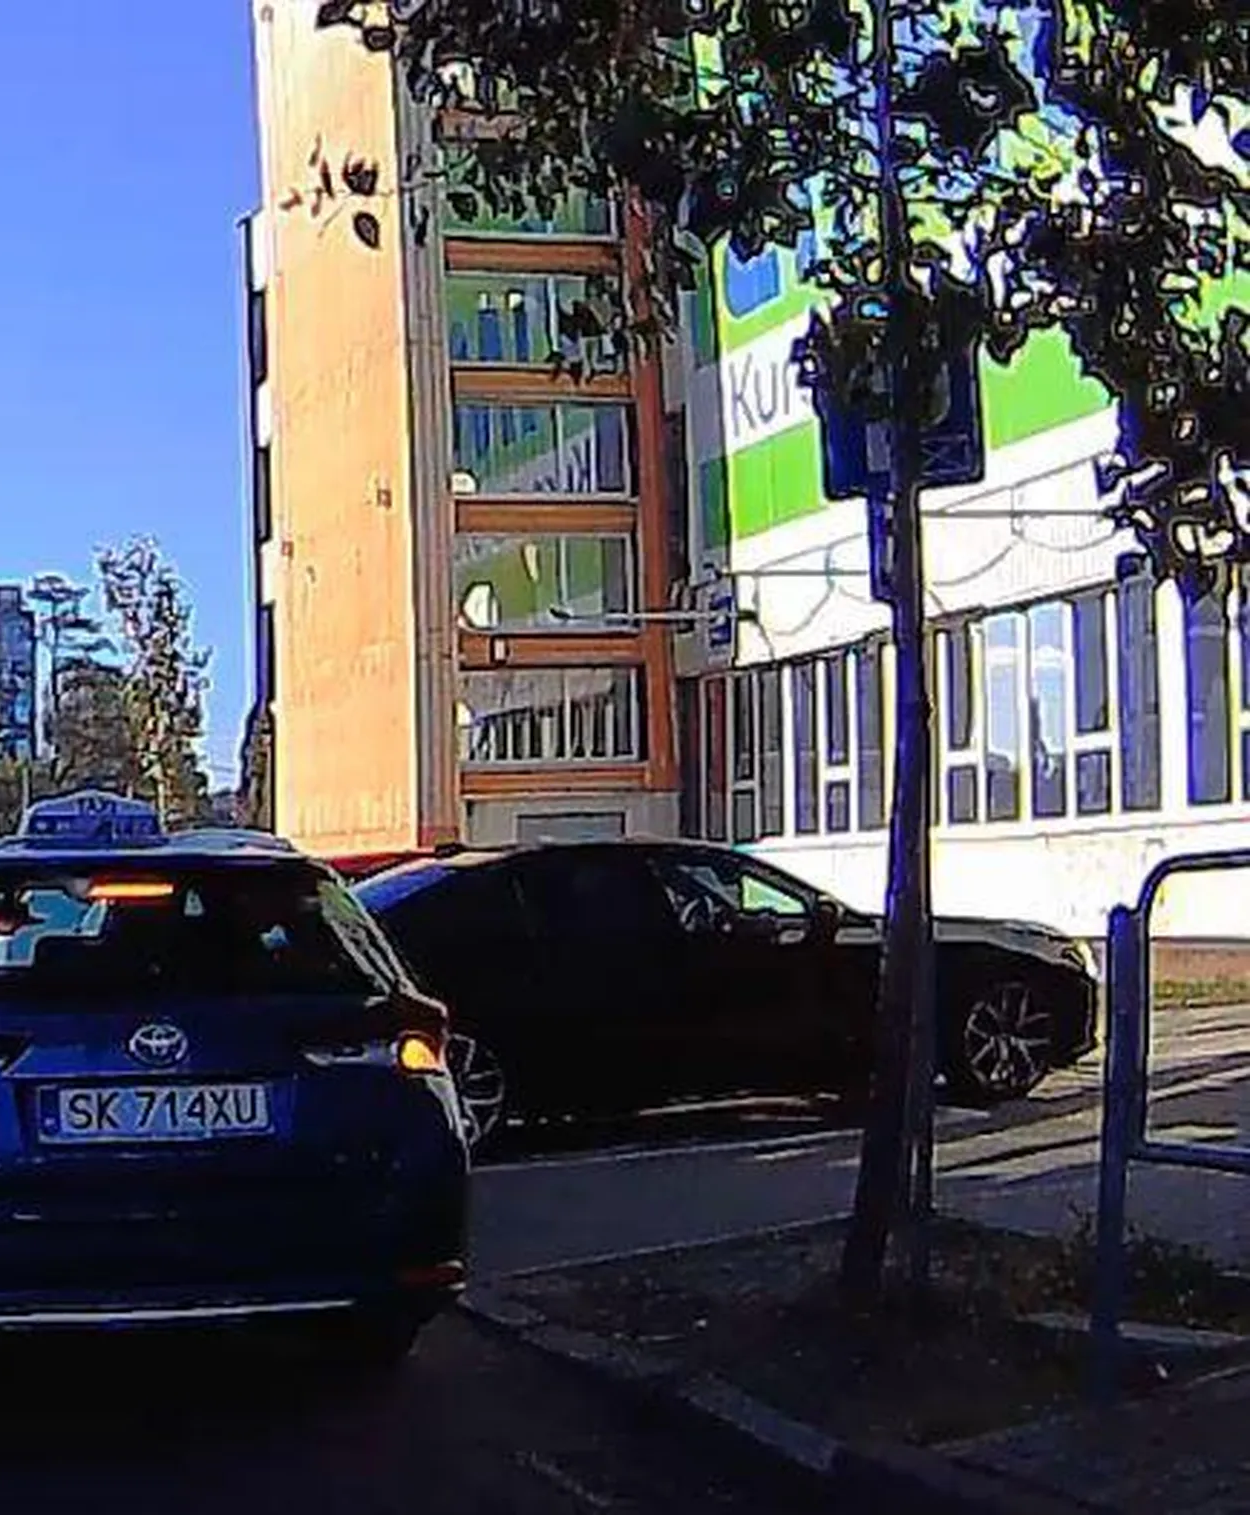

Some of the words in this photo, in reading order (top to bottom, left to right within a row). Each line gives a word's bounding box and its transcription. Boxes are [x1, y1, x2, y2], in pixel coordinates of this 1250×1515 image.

[729, 352, 809, 437] Kur
[68, 1093, 121, 1129] SK
[135, 1090, 258, 1128] 714XU
